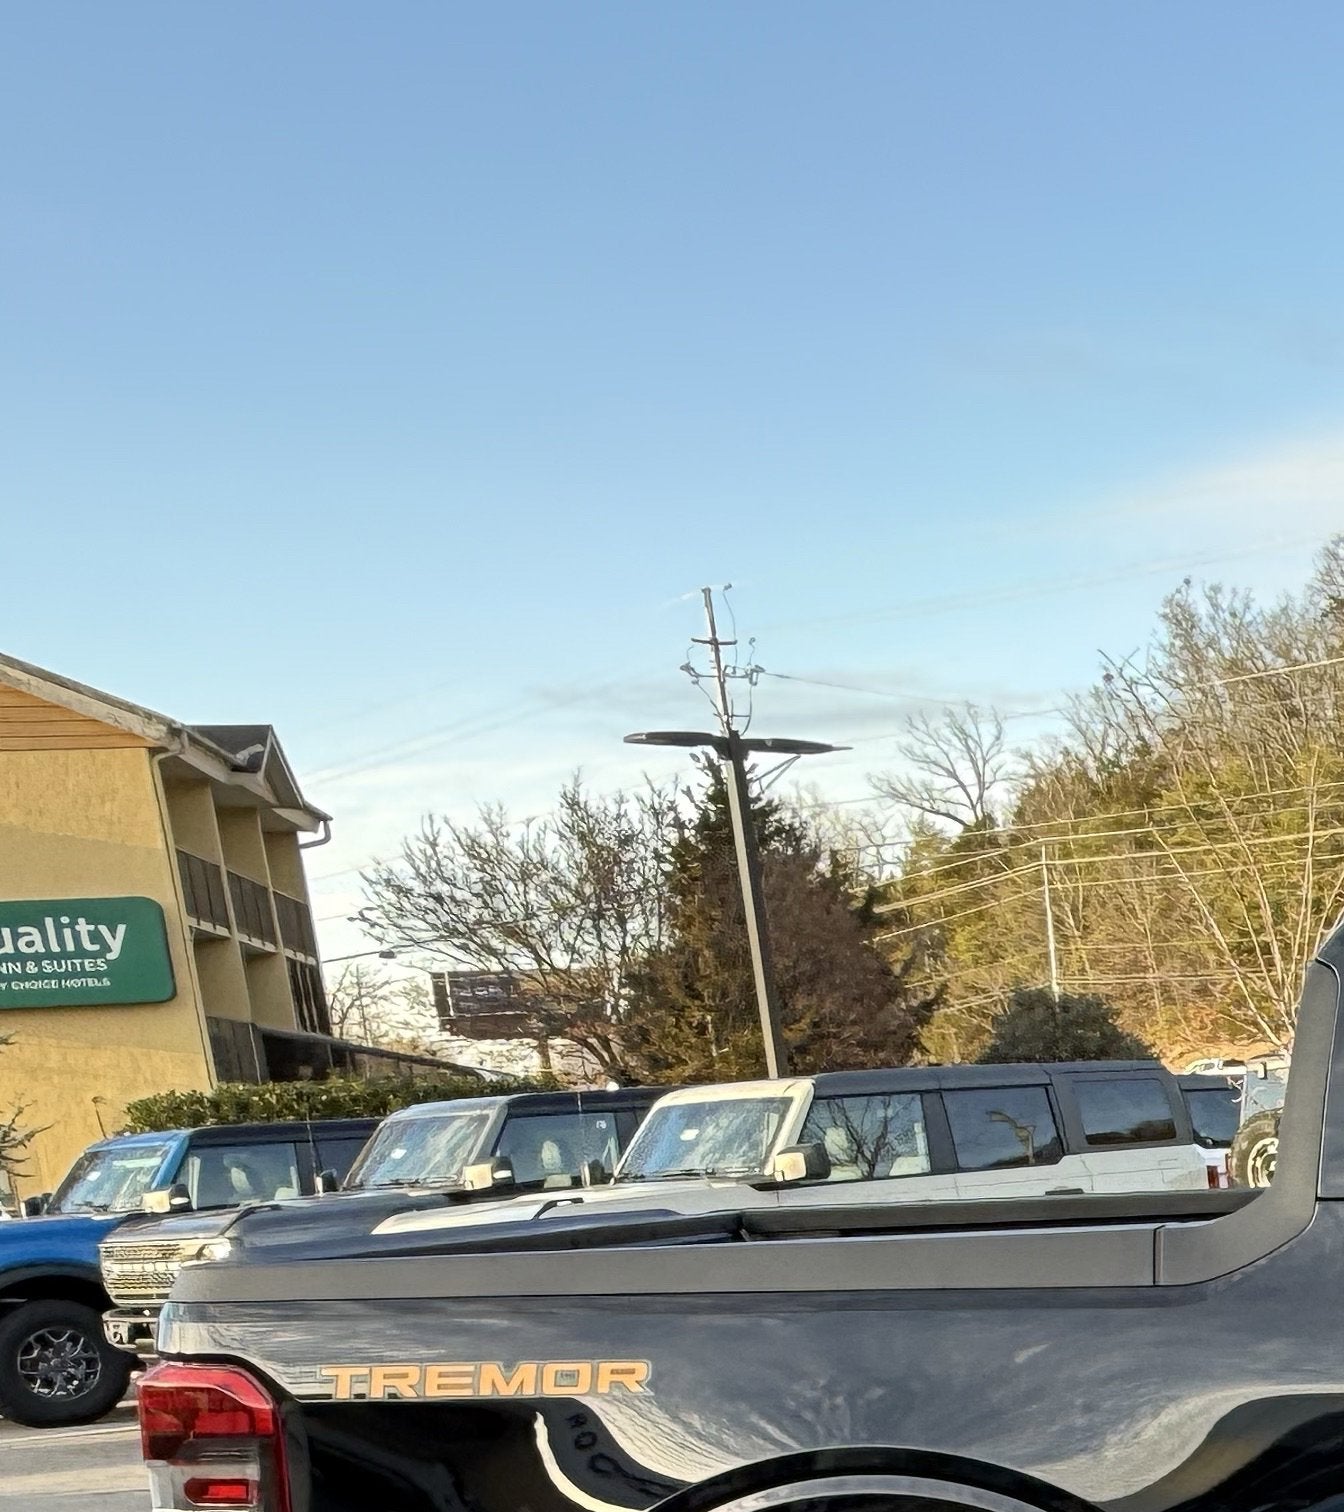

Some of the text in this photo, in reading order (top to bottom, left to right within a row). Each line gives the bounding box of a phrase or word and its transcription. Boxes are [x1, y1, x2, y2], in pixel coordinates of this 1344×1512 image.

[26, 960, 38, 974] &
[42, 958, 108, 973] SUITES
[321, 1361, 650, 1400] TREMOR
